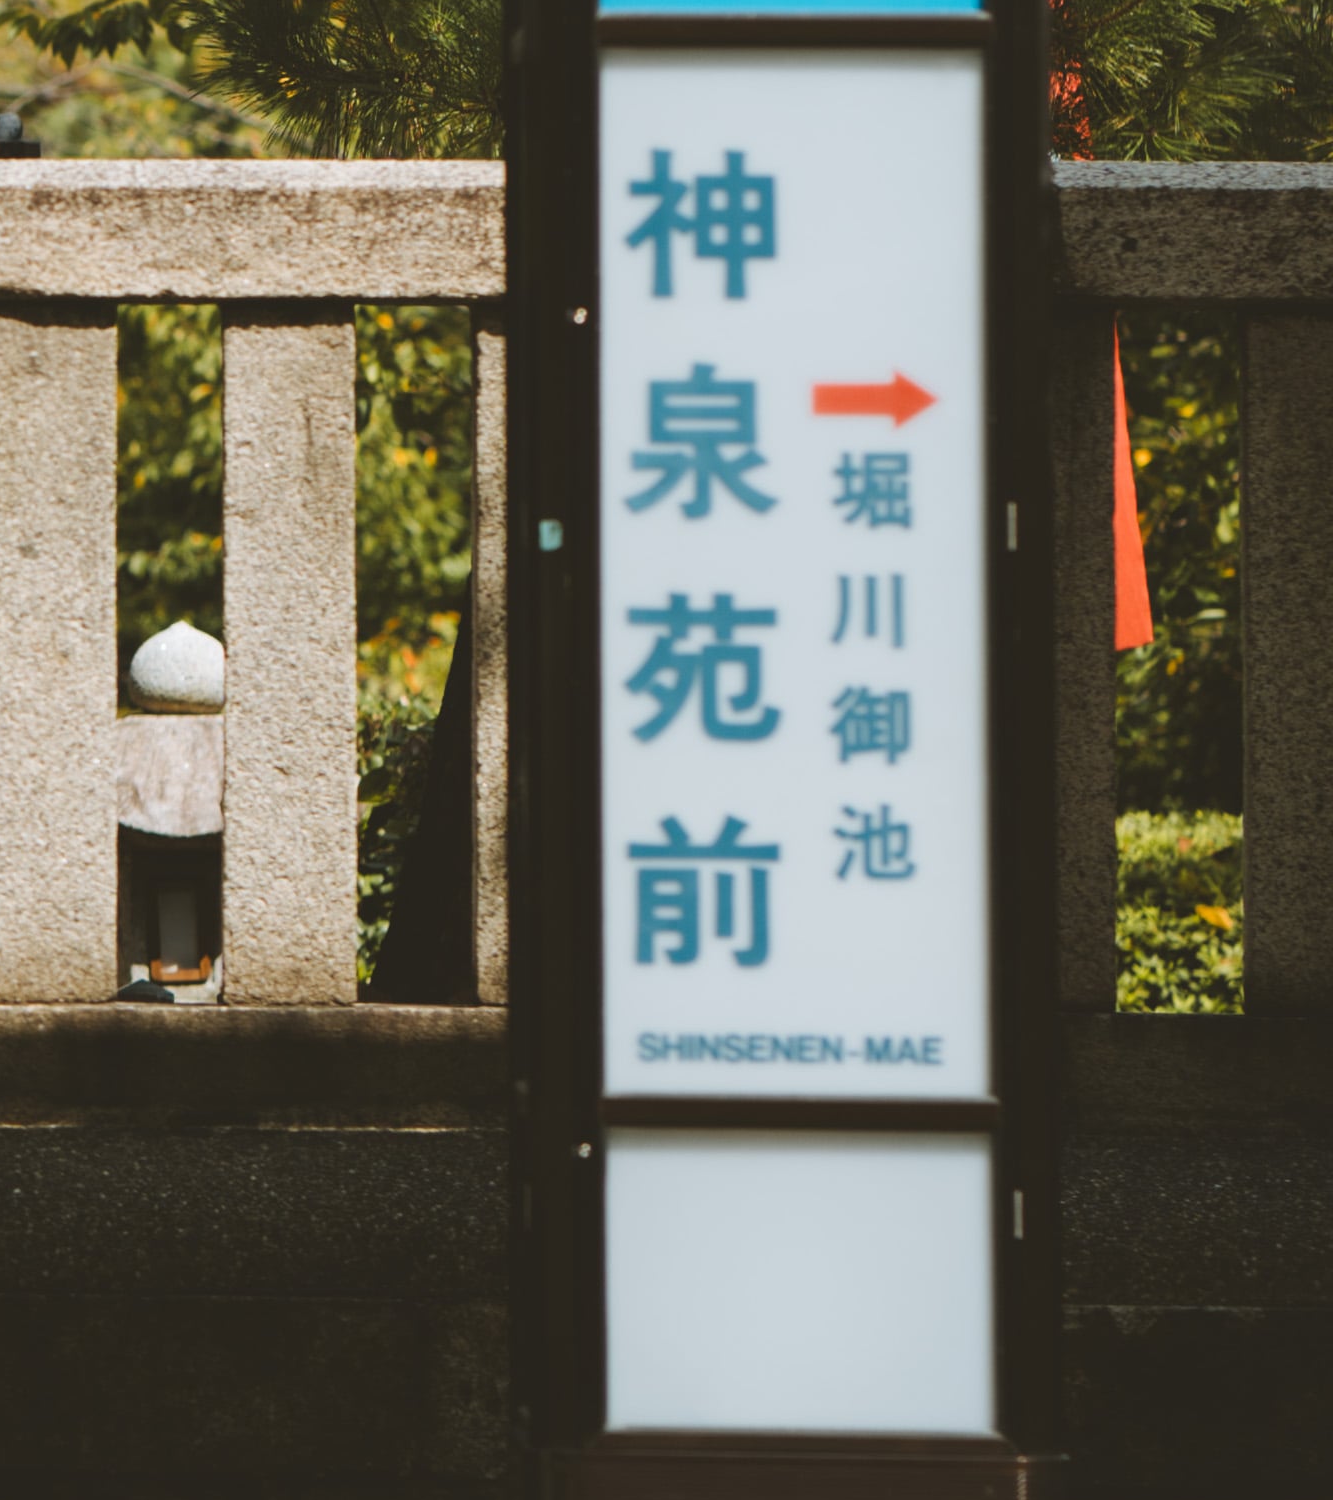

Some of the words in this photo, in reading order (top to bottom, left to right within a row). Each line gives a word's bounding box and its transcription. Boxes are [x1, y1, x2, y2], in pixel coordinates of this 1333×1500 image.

[622, 146, 784, 970] 神泉苑前
[828, 450, 918, 883] 堀川御池
[636, 1031, 943, 1067] SHINSENEN-MAE
